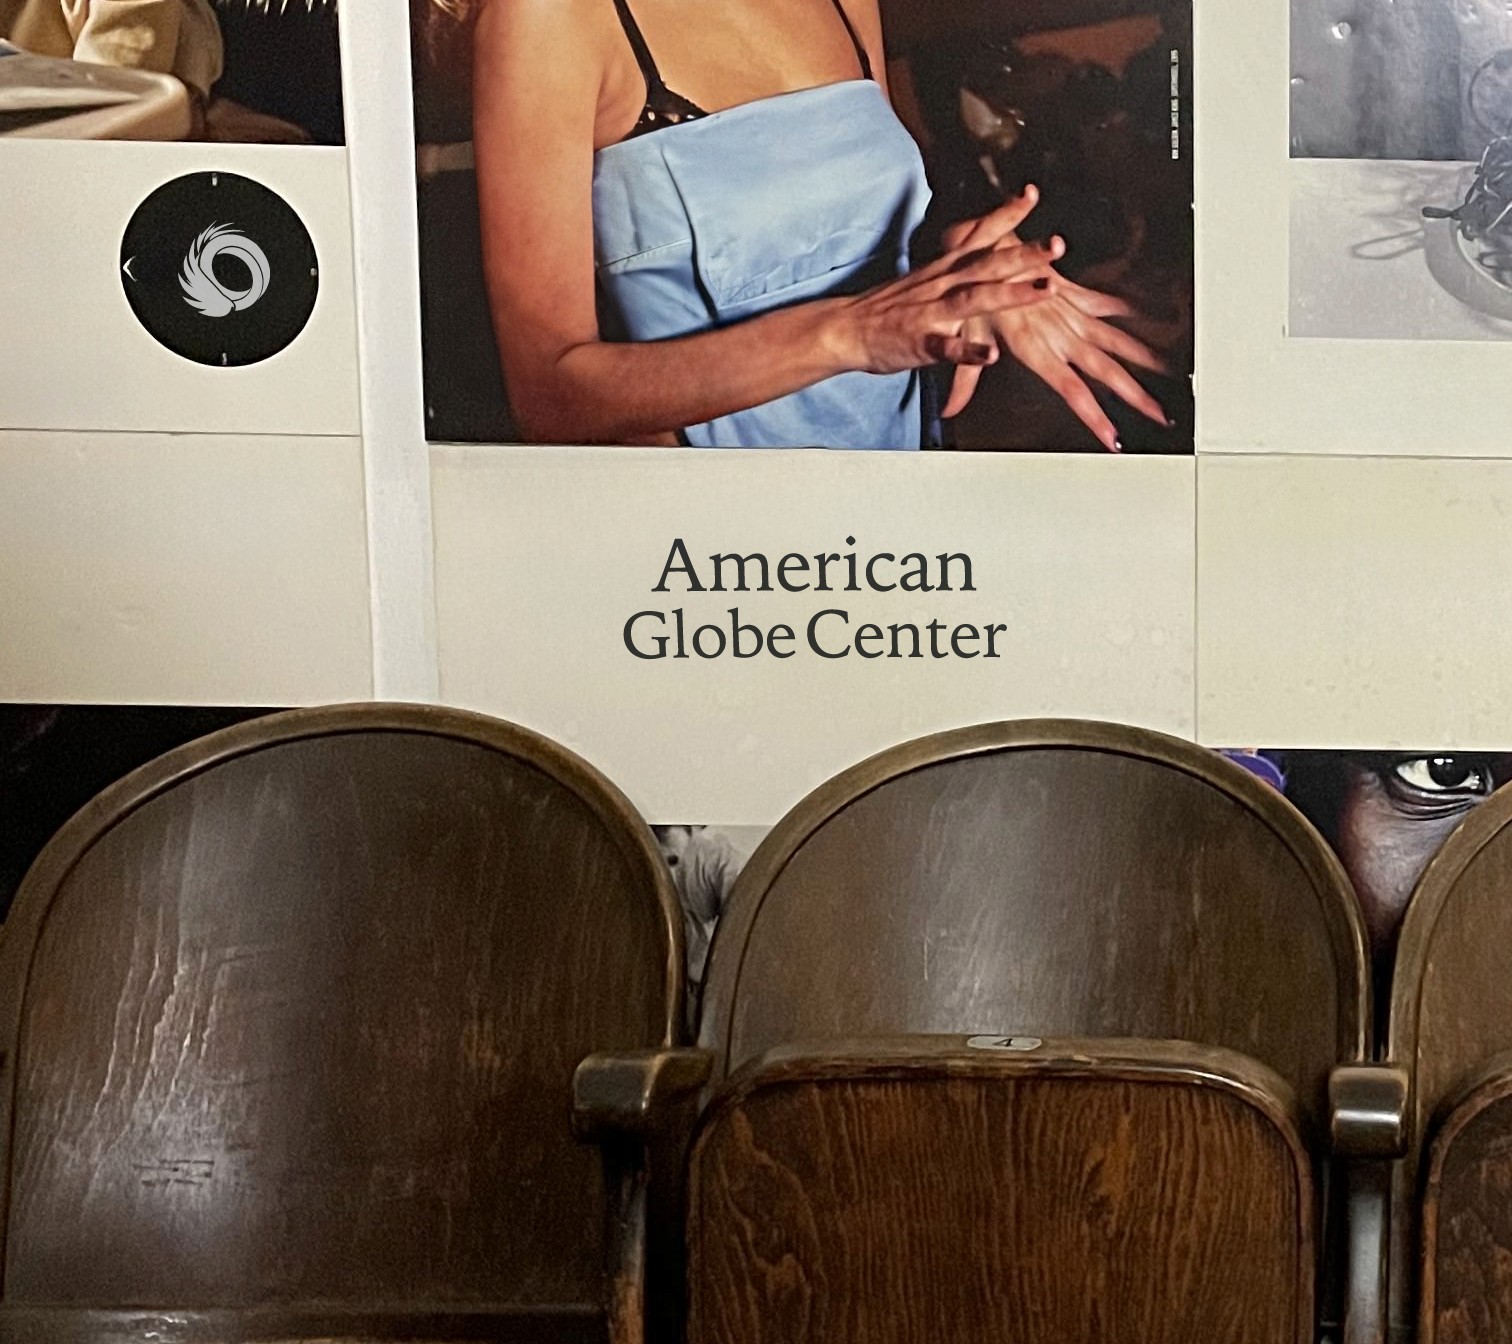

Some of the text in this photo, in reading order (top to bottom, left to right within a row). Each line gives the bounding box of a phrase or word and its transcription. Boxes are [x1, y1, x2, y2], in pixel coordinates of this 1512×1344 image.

[651, 535, 977, 593] American
[623, 606, 1008, 660] Globe Center
